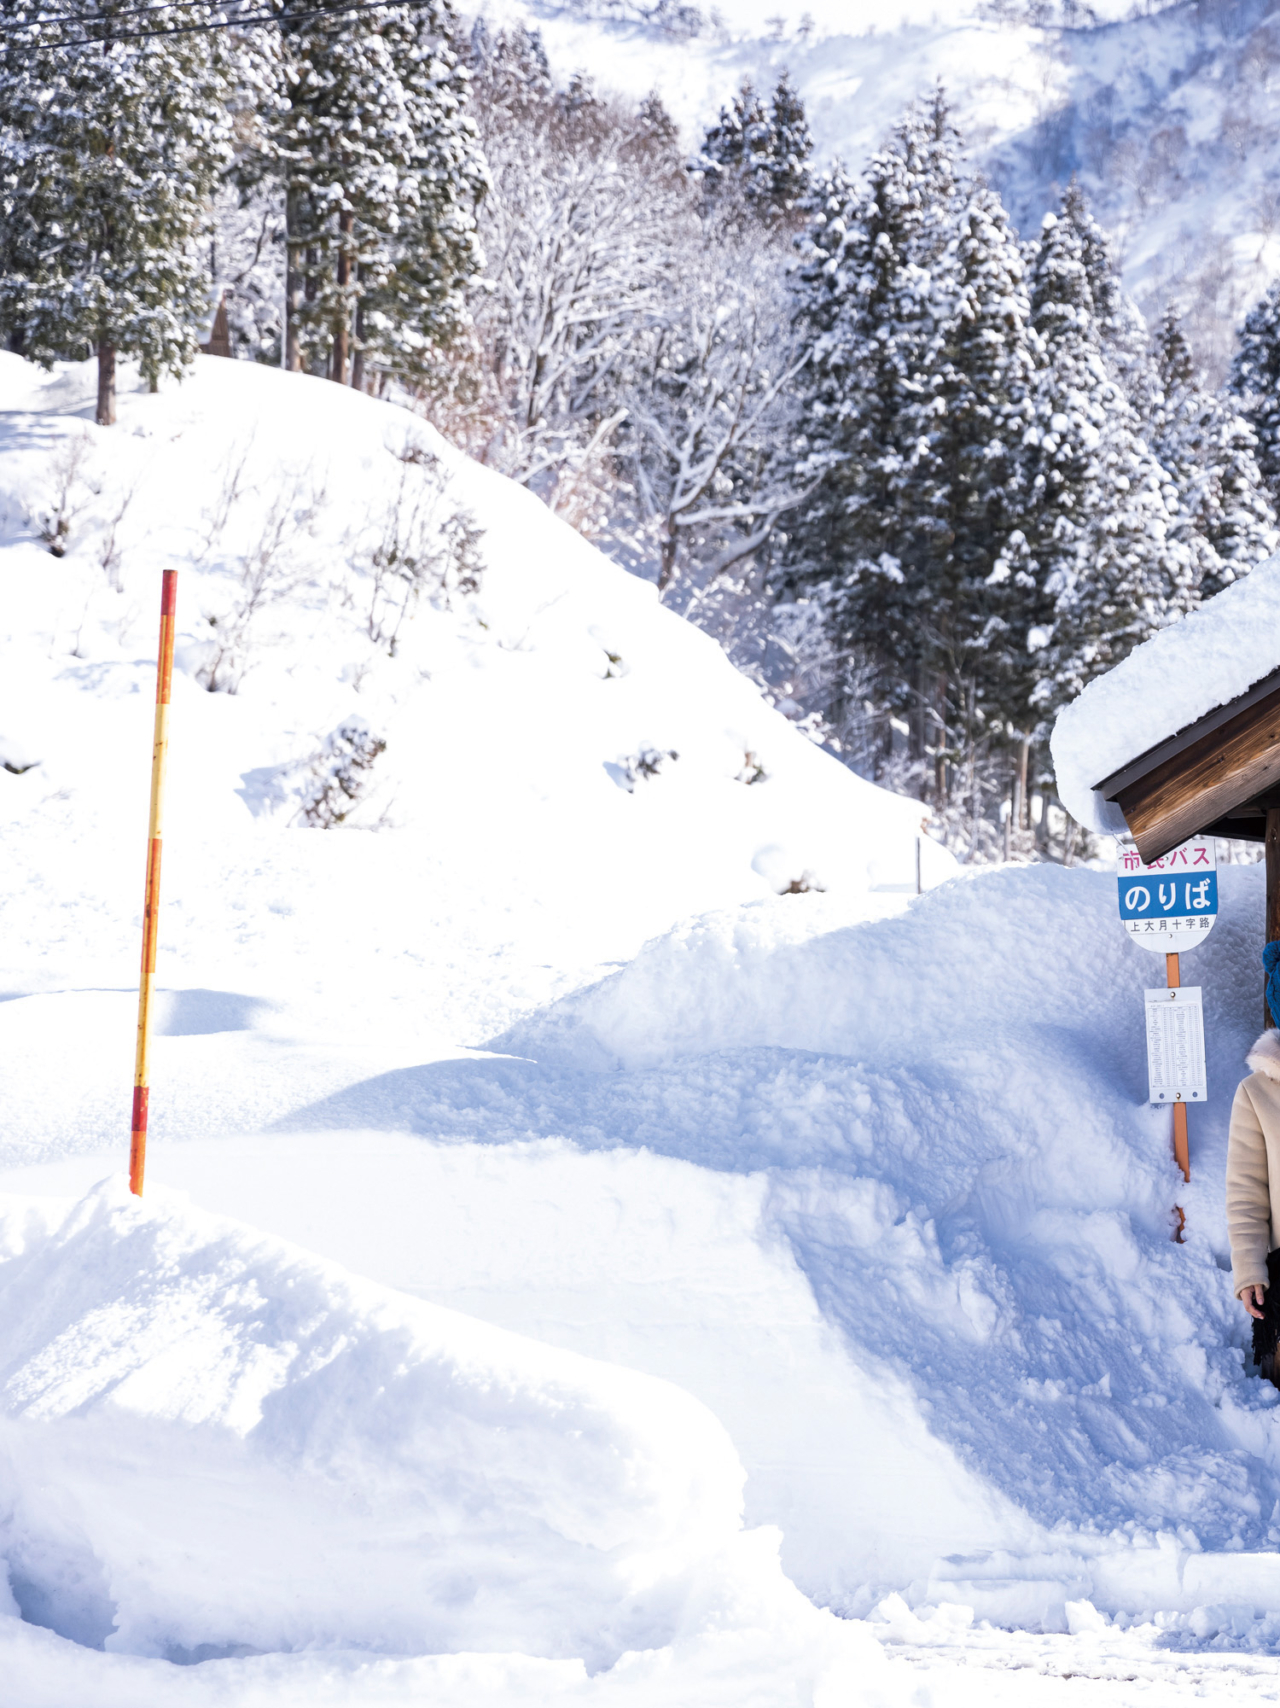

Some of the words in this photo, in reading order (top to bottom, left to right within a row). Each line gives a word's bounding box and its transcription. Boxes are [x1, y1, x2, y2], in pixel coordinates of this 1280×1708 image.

[1125, 878, 1211, 912] のりば
[1130, 917, 1210, 932] 上大月十字路
